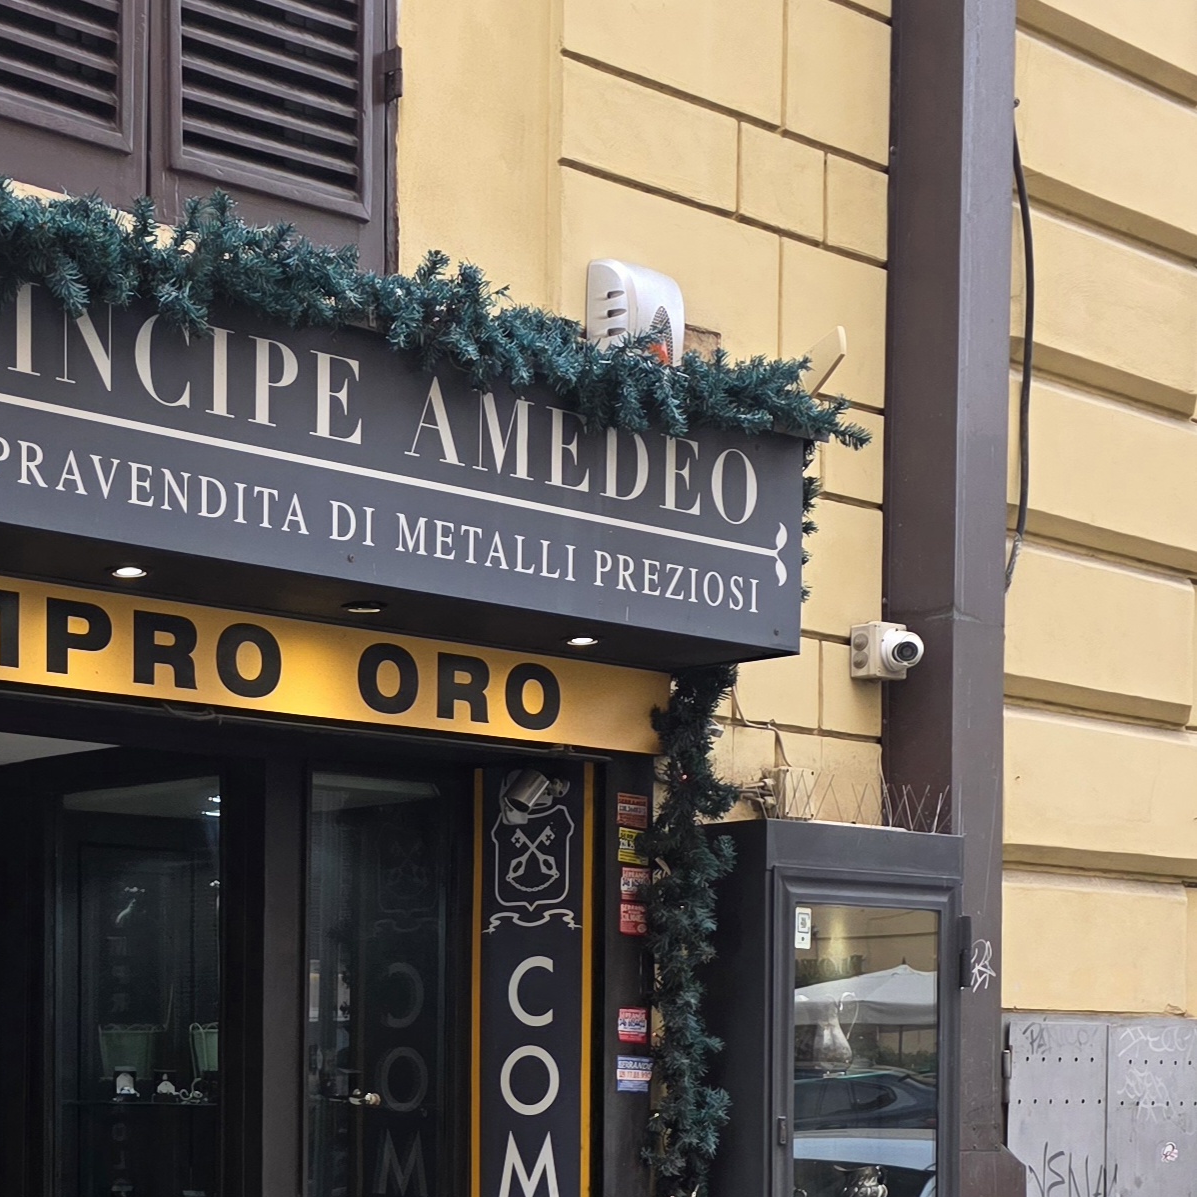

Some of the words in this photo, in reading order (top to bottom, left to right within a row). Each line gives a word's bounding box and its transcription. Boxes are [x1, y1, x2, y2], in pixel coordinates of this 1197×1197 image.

[404, 374, 759, 525] AMEDEO
[329, 500, 376, 547] DI
[395, 512, 576, 582] METALLI
[595, 550, 760, 614] PREZIOSI
[356, 641, 562, 732] ORO
